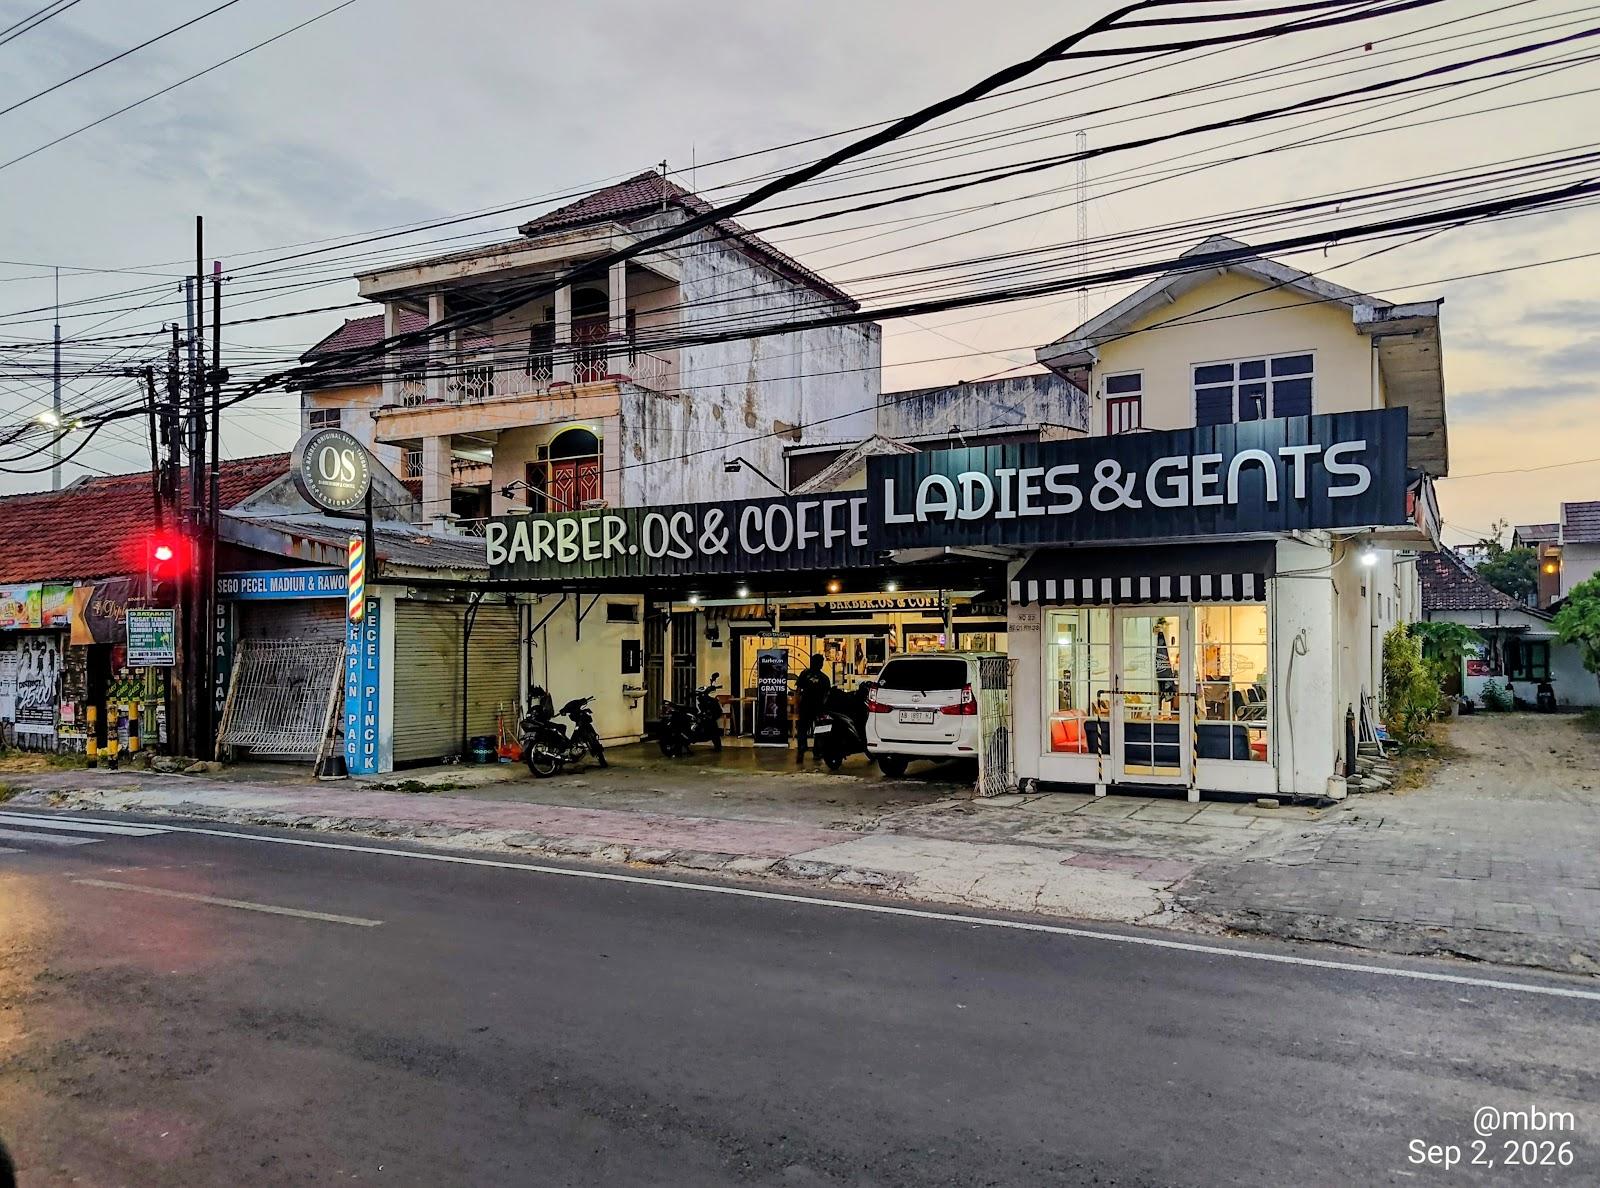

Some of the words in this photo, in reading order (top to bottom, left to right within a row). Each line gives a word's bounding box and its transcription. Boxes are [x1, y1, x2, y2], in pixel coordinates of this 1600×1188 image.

[318, 446, 356, 483] OS
[884, 464, 1081, 524] LADIES
[1089, 458, 1142, 512] &
[1145, 440, 1372, 508] GENTS
[486, 510, 694, 566] BARBER.OS
[217, 579, 239, 593] SEGO
[241, 578, 267, 593] PECEL
[270, 576, 305, 591] MADIUN
[308, 575, 315, 591] &
[907, 596, 956, 608] COFF
[216, 604, 225, 657] BUKA
[366, 601, 377, 670] PECEL
[348, 622, 359, 697] RAPAN
[347, 714, 357, 768] PAGI
[364, 686, 376, 769] PINCUK
